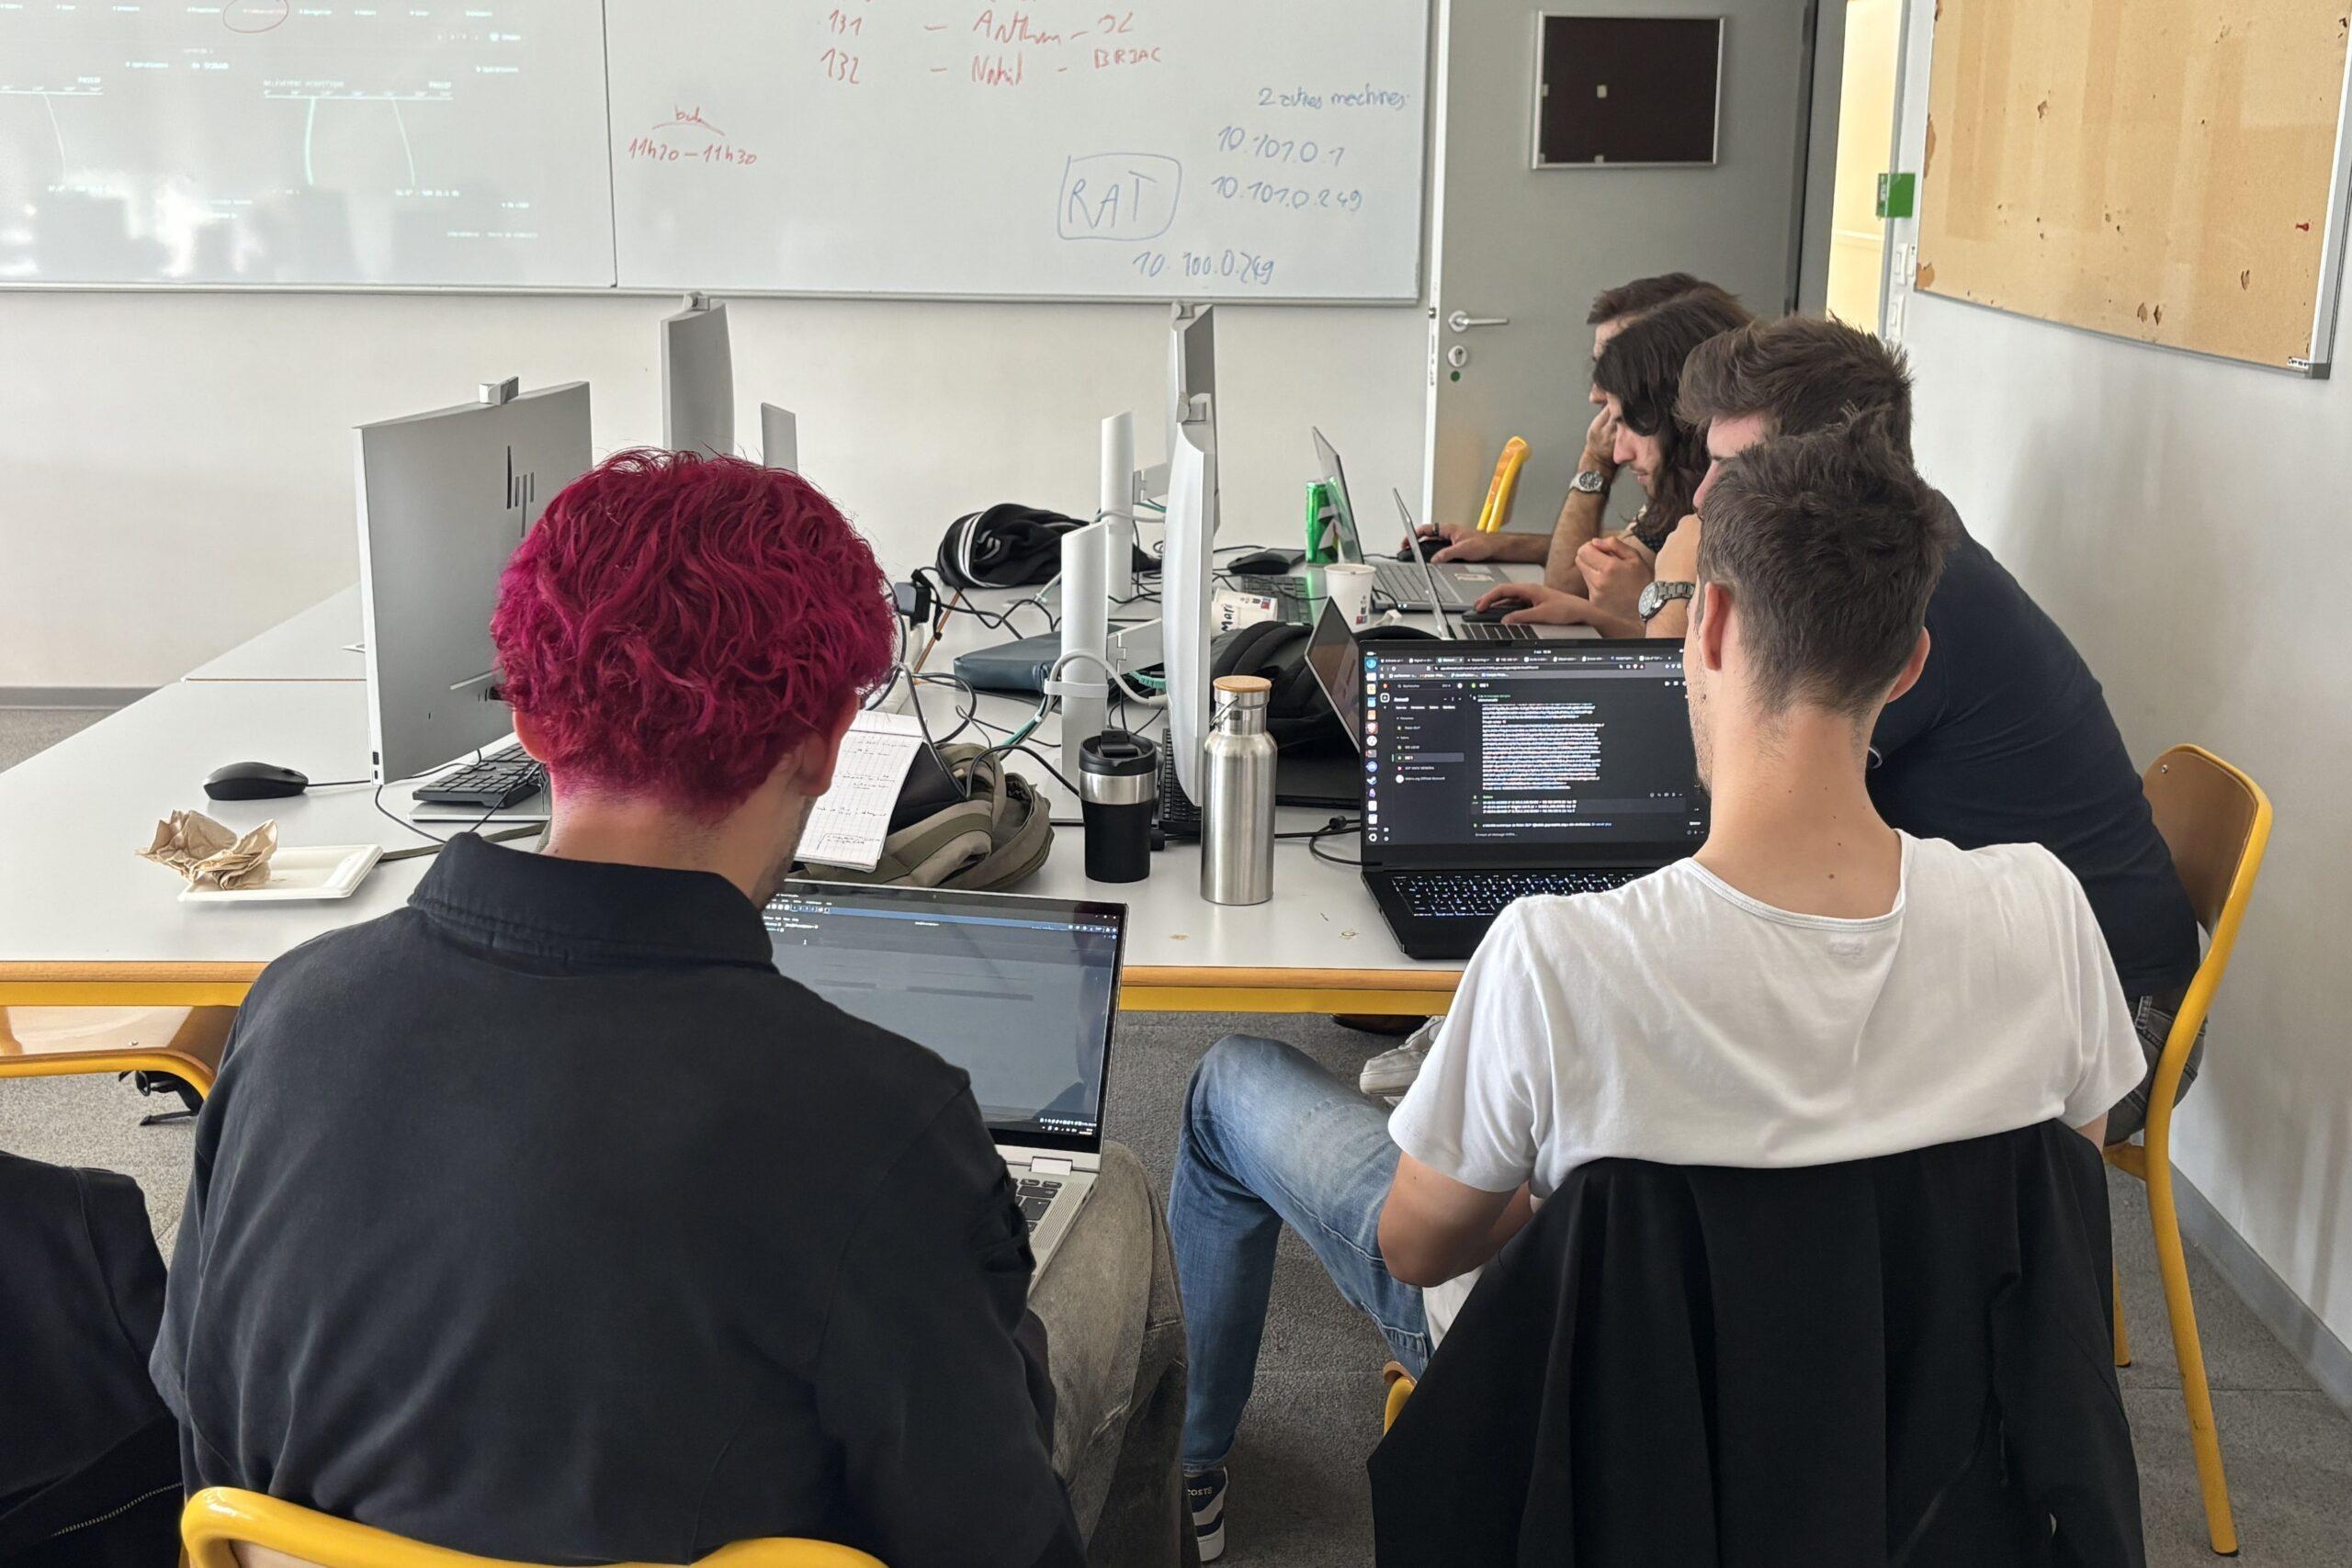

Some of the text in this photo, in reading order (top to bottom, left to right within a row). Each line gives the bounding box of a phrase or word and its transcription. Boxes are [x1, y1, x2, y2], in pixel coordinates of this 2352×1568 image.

[829, 9, 862, 36] 131
[820, 48, 860, 85] 132
[1259, 87, 1275, 106] 2
[1069, 170, 1157, 228] RAT
